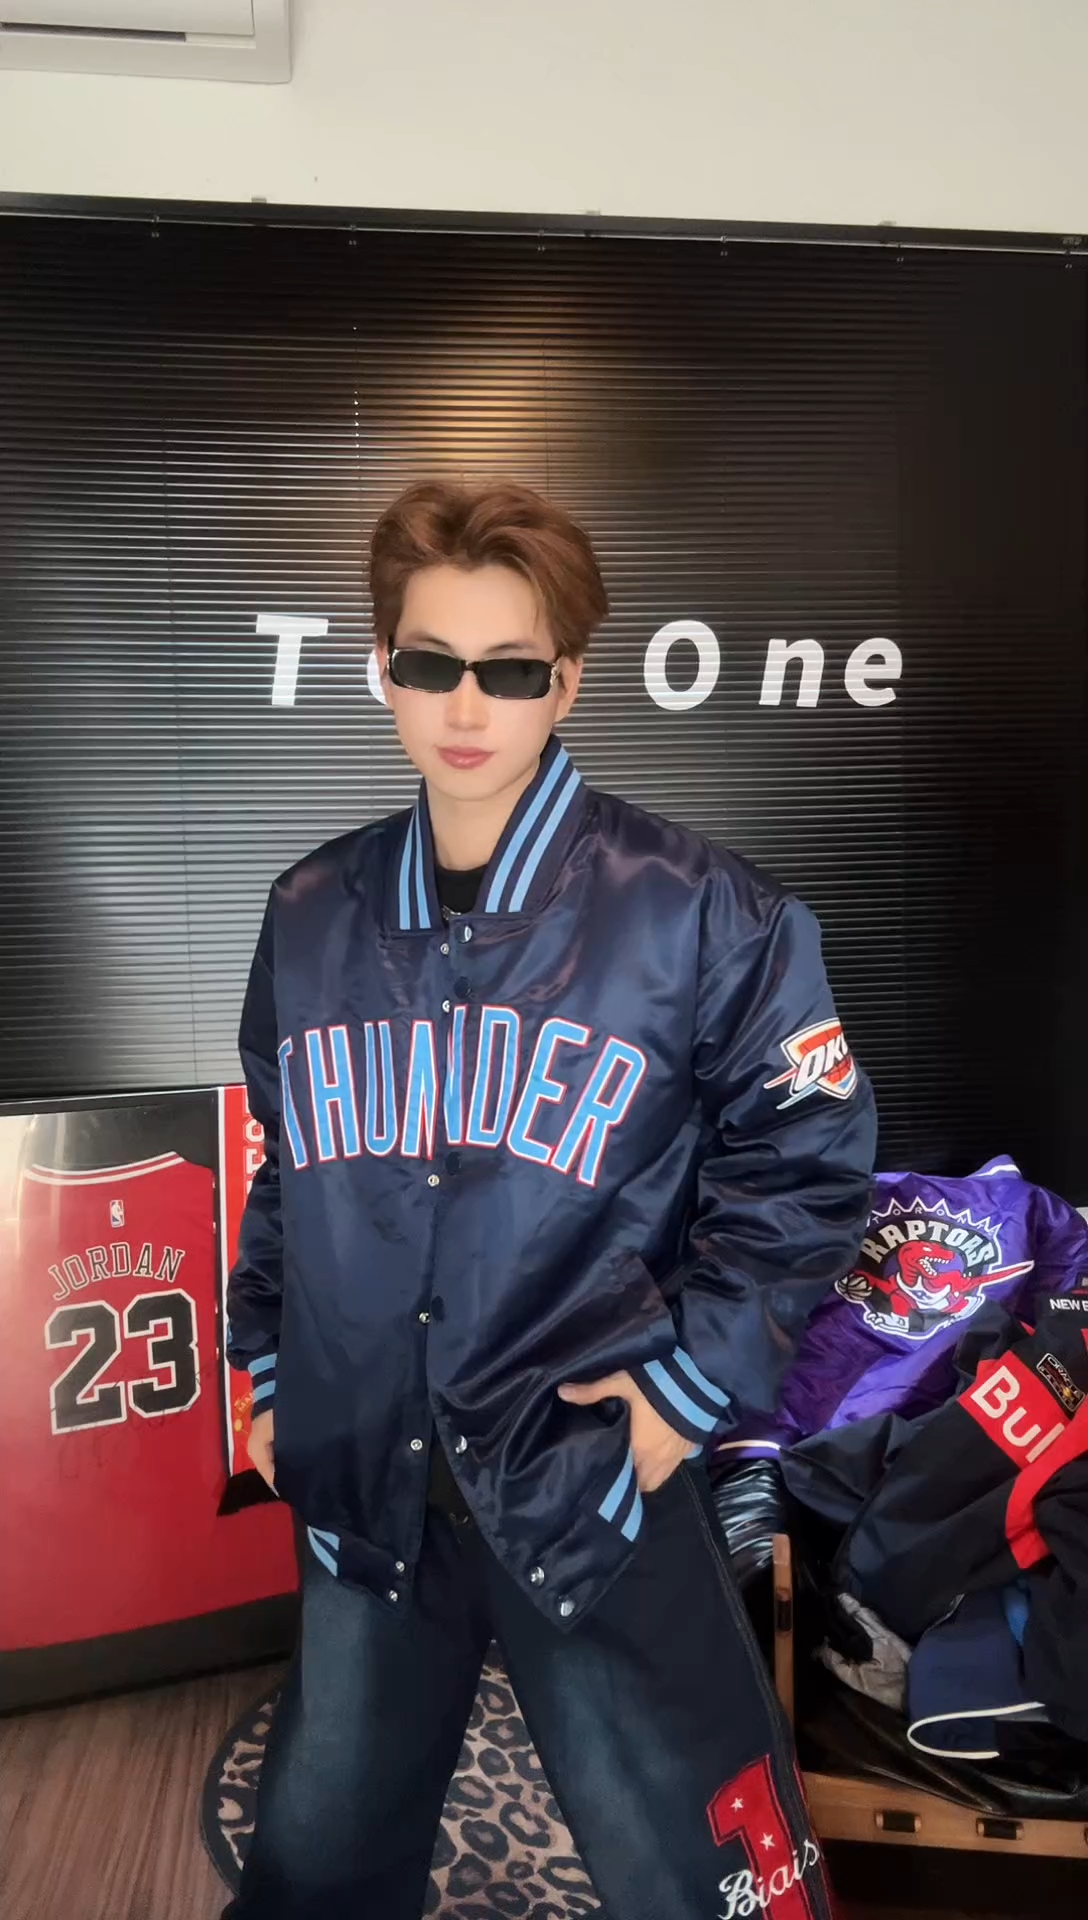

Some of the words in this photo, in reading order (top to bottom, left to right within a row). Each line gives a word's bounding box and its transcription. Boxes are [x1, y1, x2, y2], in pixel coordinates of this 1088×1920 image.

[255, 614, 388, 706] T
[644, 619, 903, 711] One
[276, 1003, 647, 1188] THUNDER
[48, 1241, 185, 1300] JORDAN
[861, 1219, 996, 1268] RAPTORS
[1049, 1298, 1081, 1311] NEW
[44, 1288, 201, 1435] 23
[717, 1838, 820, 1920] Biais
